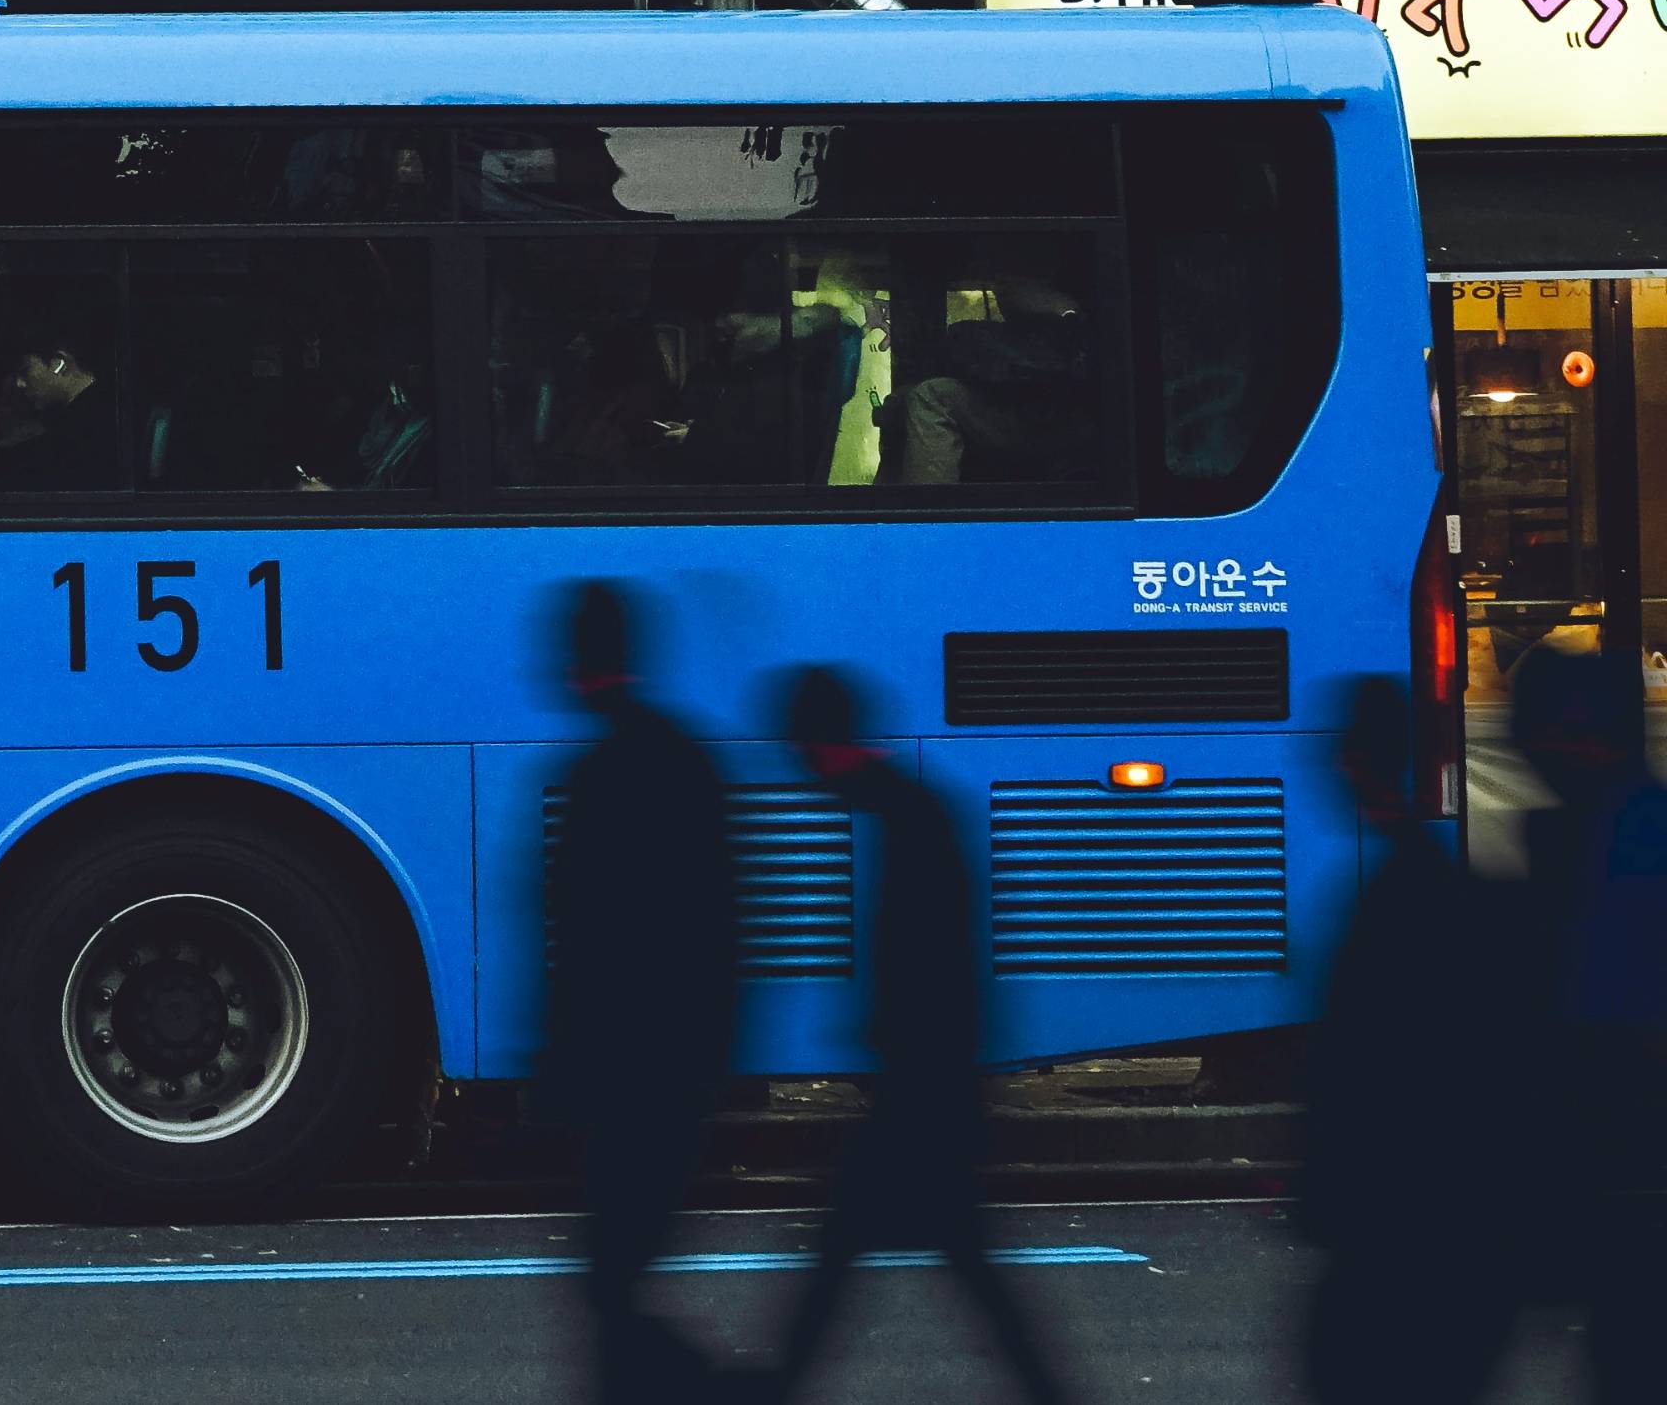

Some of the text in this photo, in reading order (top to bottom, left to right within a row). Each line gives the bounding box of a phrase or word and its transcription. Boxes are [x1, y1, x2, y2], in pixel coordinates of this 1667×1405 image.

[1132, 558, 1287, 600] 동아운수
[52, 559, 283, 672] 151
[1133, 602, 1288, 613] DONG-A TRANSIT SERVICE
